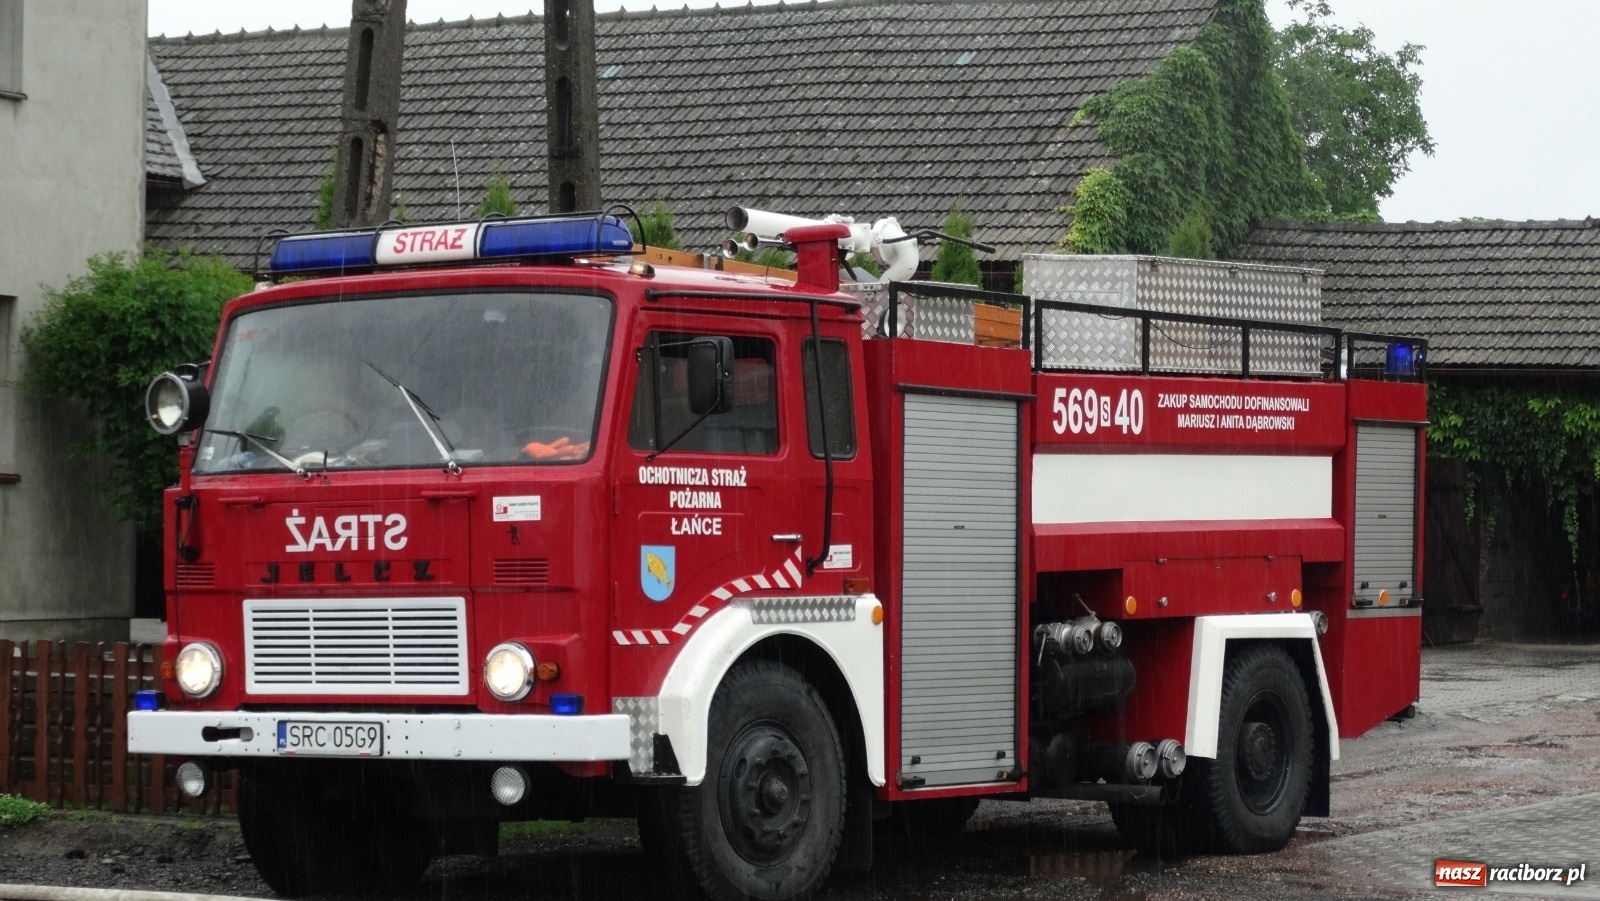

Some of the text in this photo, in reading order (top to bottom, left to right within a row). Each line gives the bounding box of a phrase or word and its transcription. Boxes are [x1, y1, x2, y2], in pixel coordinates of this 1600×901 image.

[1052, 387, 1098, 434] 569
[1114, 388, 1144, 434] 40
[1158, 393, 1310, 412] ZAKUP SAMOCHODU DOFINANSOWALI
[1177, 414, 1295, 432] MARIUSZ I ANITA DĄBROWSKI
[639, 466, 747, 487] OCHOTNICZA STRAŻ
[669, 487, 722, 509] POŻARNA
[671, 513, 722, 535] ŁAŃCE
[261, 560, 435, 583] JELCZ
[290, 725, 377, 748] SRC 05G9
